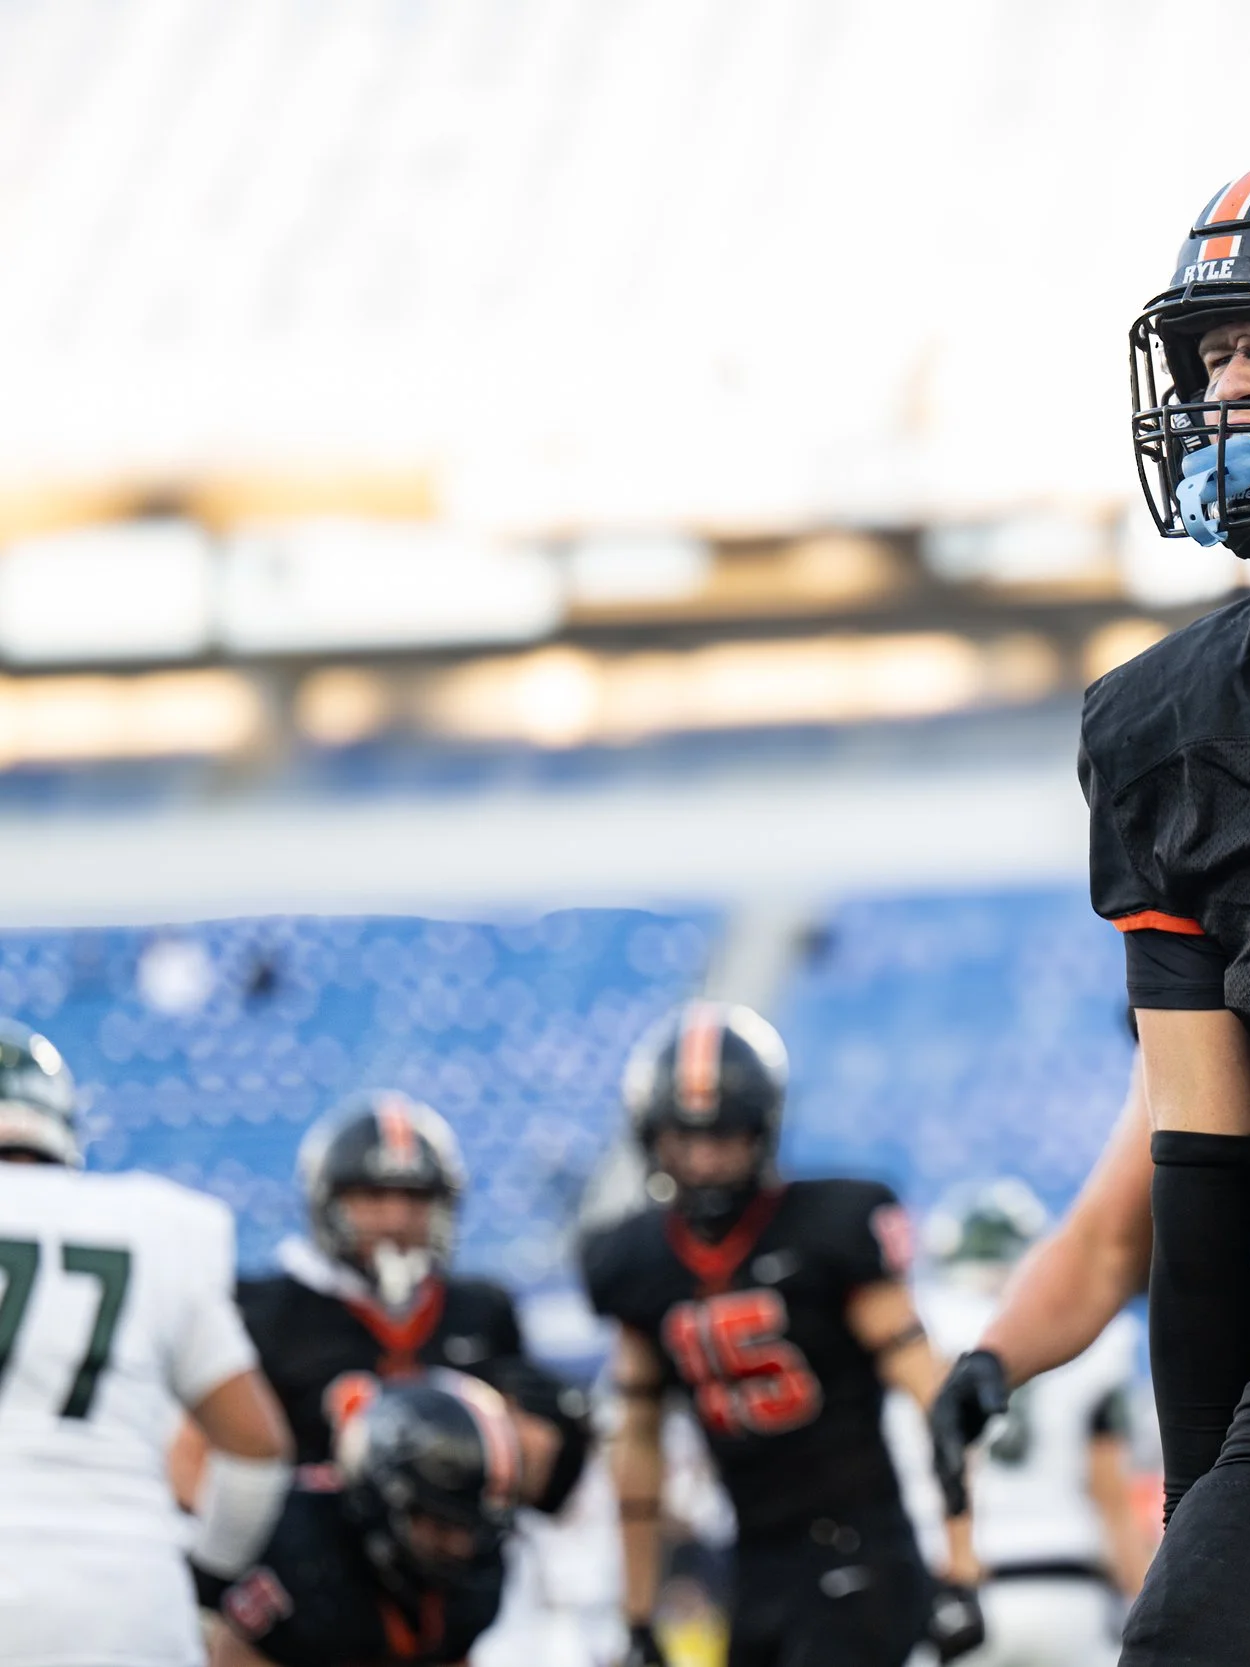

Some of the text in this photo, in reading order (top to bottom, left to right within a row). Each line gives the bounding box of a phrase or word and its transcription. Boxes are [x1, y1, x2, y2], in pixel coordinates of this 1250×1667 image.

[1183, 259, 1235, 284] RYLE
[0, 1238, 132, 1420] 77
[662, 1287, 823, 1437] 15
